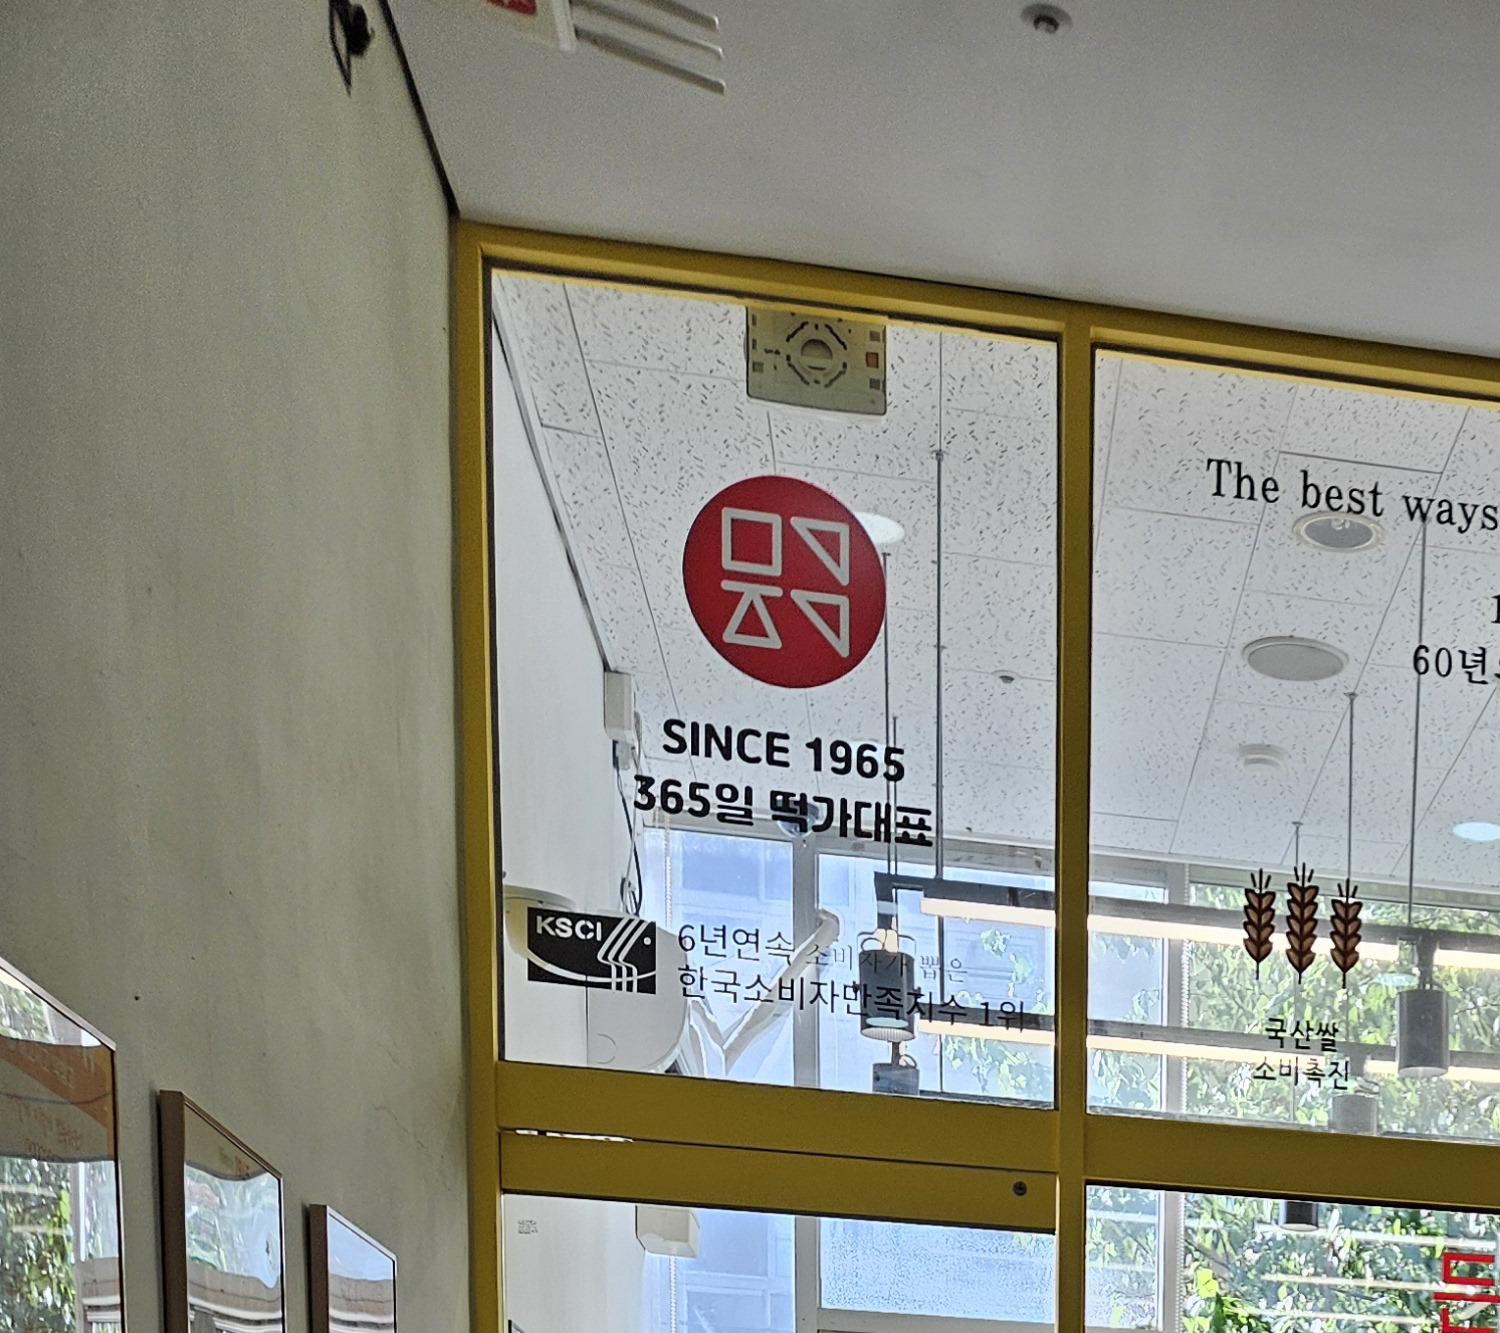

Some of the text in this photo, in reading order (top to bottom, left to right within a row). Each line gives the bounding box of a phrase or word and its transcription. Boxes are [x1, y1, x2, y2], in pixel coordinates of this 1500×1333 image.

[1206, 458, 1280, 505] The
[1300, 469, 1385, 518] best
[1402, 490, 1500, 533] ways
[661, 717, 906, 784] SINCE 1965
[632, 773, 934, 849] 365일 떡가대표
[534, 914, 604, 943] KSCI
[677, 922, 797, 966] 6년연속
[919, 952, 970, 985] 뽑은
[978, 998, 1027, 1034] 1위
[1262, 1014, 1342, 1054] 국산쌀
[1251, 1055, 1351, 1092] 소비촉진
